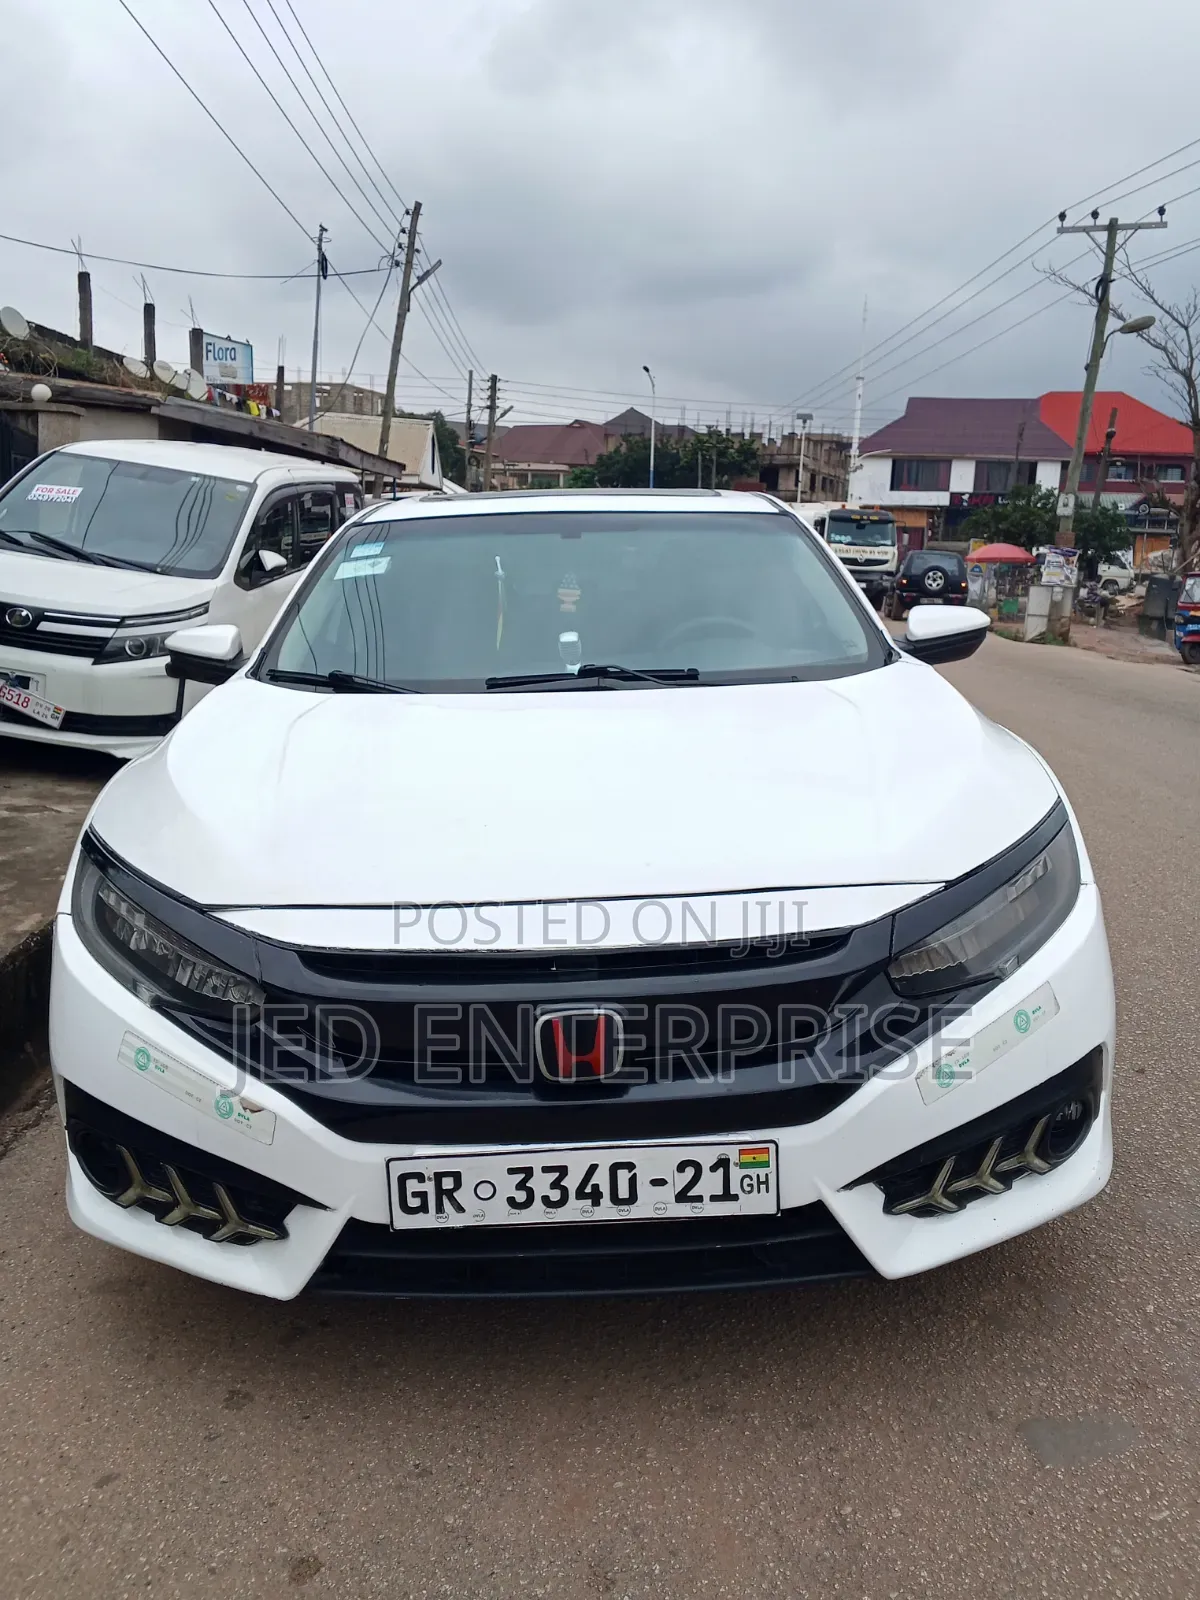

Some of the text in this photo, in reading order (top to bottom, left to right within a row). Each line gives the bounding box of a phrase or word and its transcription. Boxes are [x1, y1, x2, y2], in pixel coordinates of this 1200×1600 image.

[205, 341, 237, 361] Flora
[35, 486, 54, 494] FOR
[397, 1171, 466, 1215] GR
[739, 1173, 770, 1195] GH
